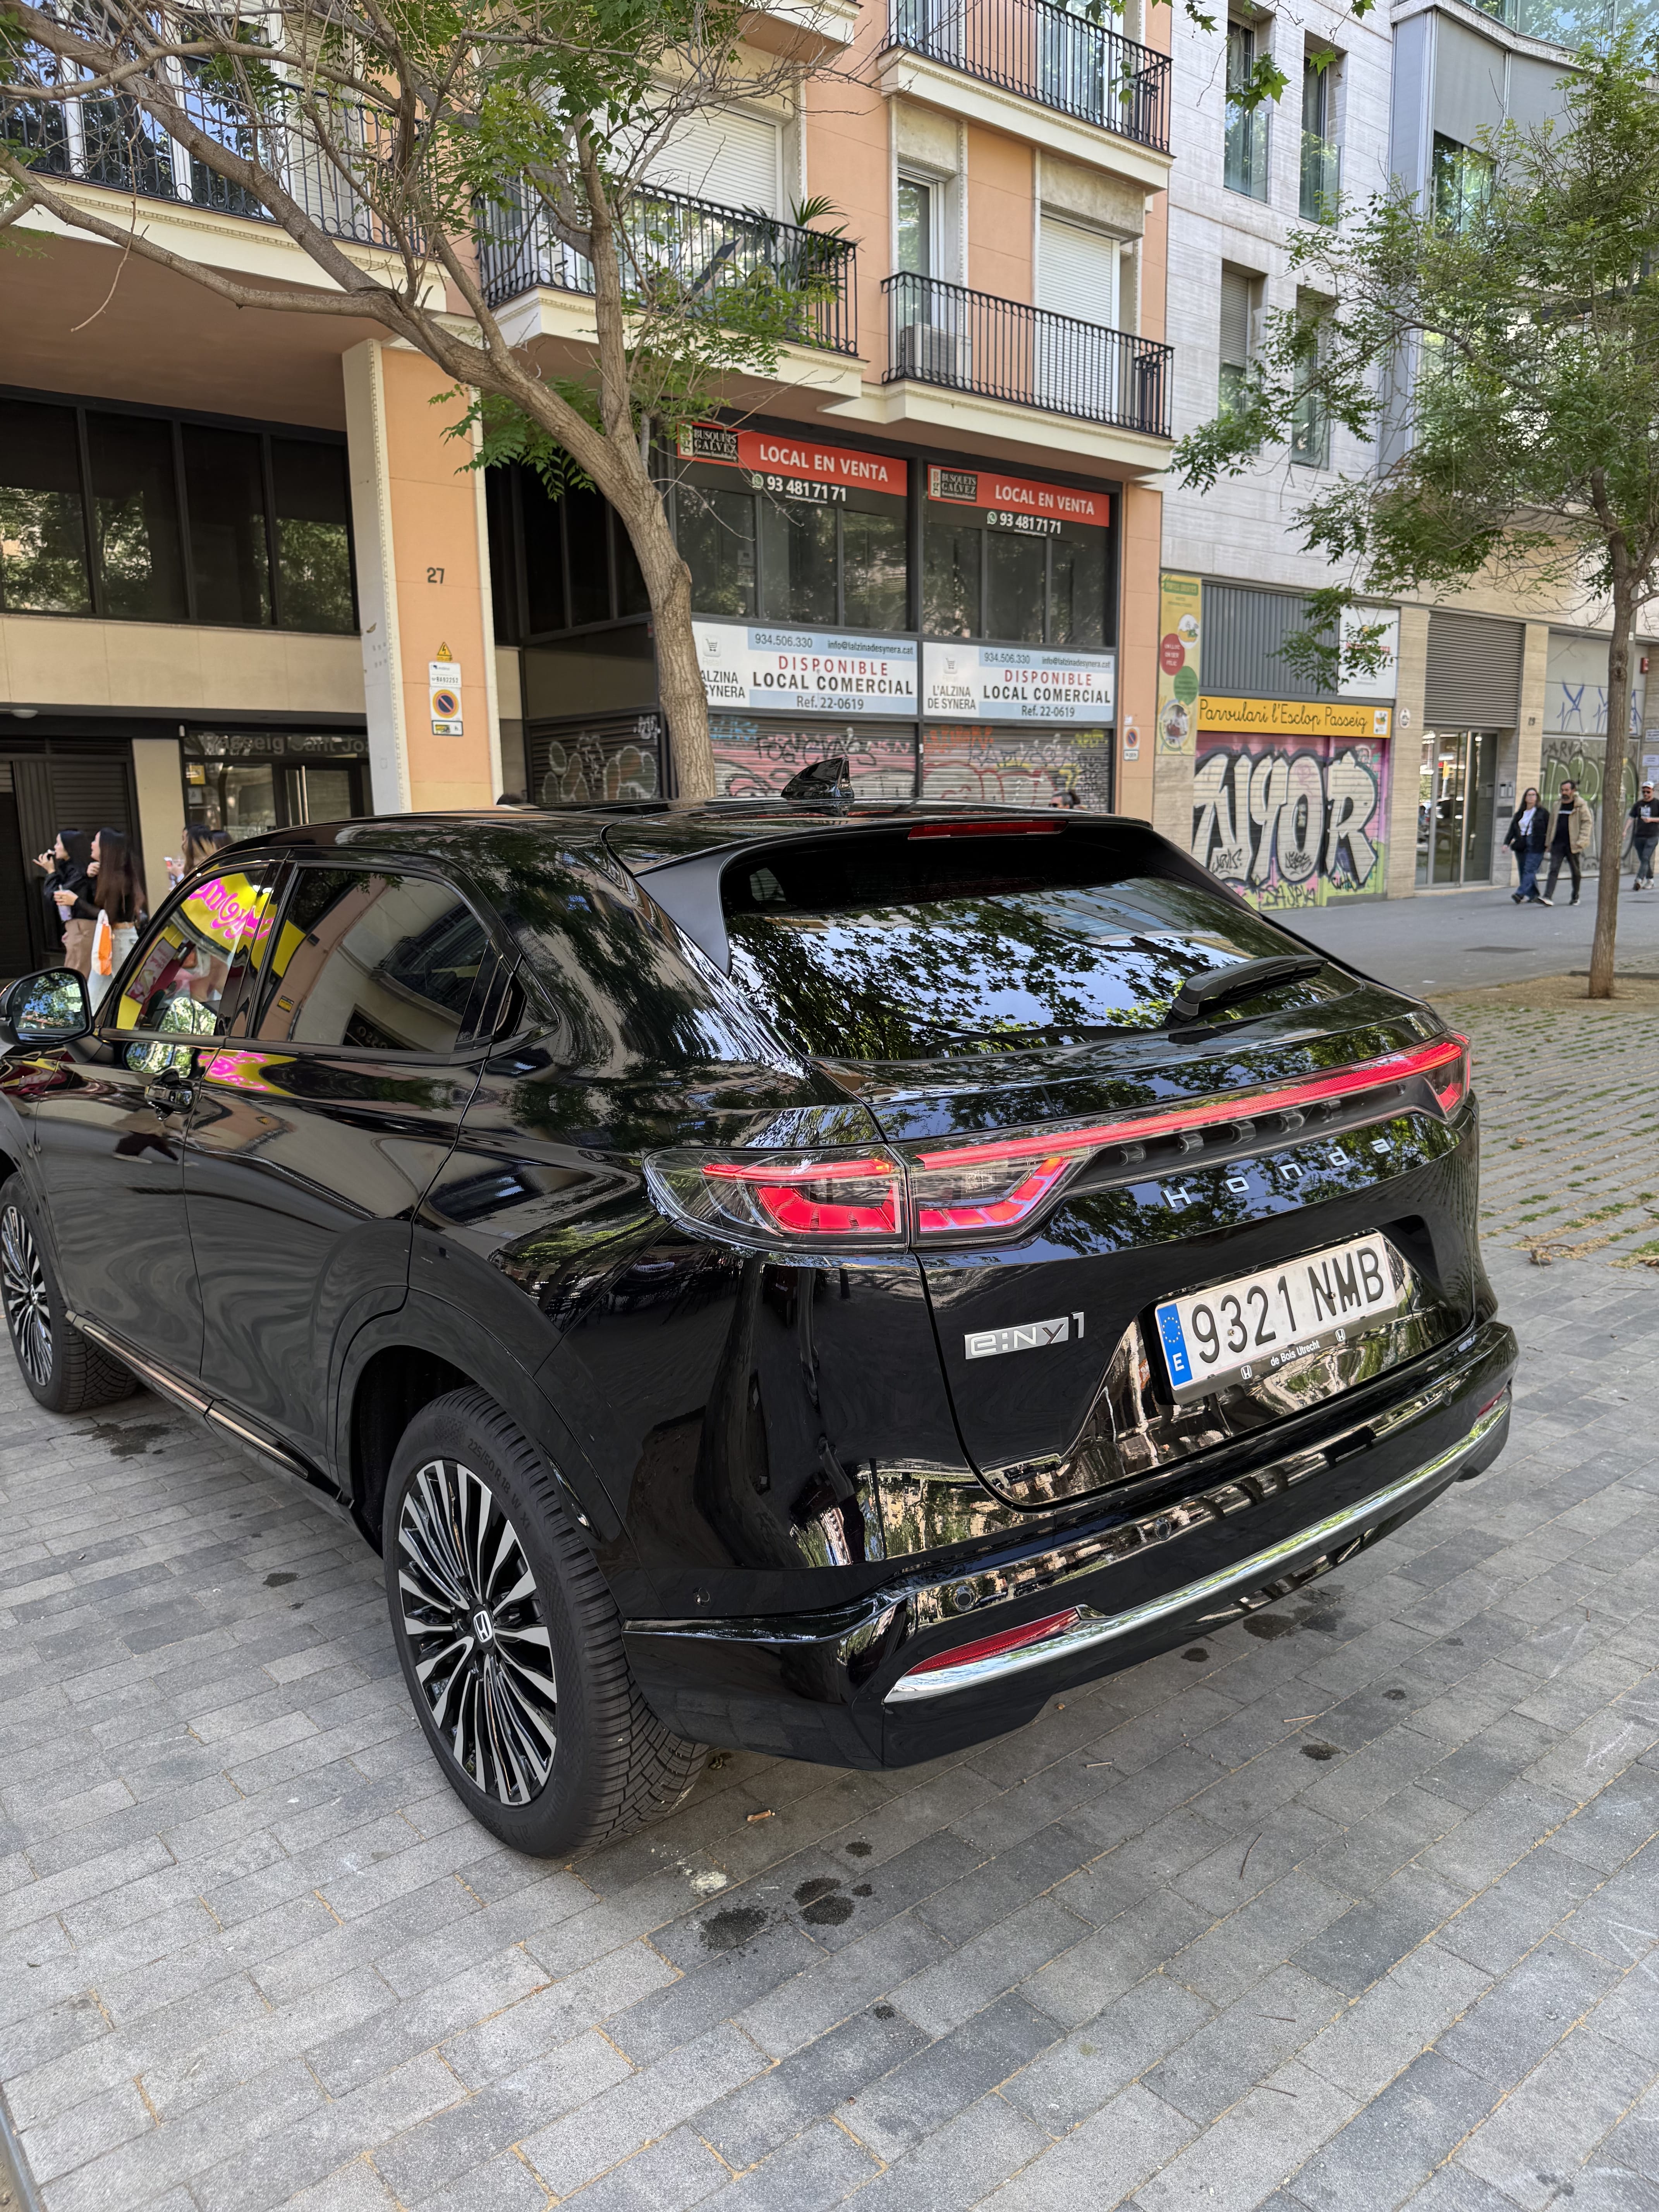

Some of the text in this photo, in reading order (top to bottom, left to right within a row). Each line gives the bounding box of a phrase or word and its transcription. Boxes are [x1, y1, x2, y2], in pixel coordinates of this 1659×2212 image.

[760, 444, 888, 483] LOCAL EN VENTA
[767, 476, 783, 492] 93
[786, 479, 809, 496] 481
[812, 483, 828, 499] 71
[831, 486, 846, 502] 71
[942, 473, 976, 485] BUSQUETS
[995, 484, 1034, 505] LOCAL
[1039, 494, 1053, 508] EN
[1057, 496, 1094, 516] VENTA
[1000, 513, 1013, 527] 93
[1015, 515, 1034, 530] 481
[1036, 518, 1048, 532] 71
[1049, 520, 1061, 534] 71
[426, 567, 445, 584] 27
[755, 634, 813, 649] 934.506.330
[779, 655, 889, 677] DISPONIBLE
[984, 652, 1030, 665] 934.506.330
[701, 670, 738, 684] ALZINA
[753, 672, 913, 695] LOCAL COMERCIAL
[1005, 670, 1092, 687] DISPONIBLE
[933, 685, 970, 697] L'ALZINA
[983, 685, 1111, 704] LOCAL COMERCIAL
[797, 696, 864, 710] Ref. 22-0619
[927, 698, 977, 710] DE SYNERA
[1021, 705, 1075, 717] Ref. 22-0619
[1200, 699, 1267, 723] Parvulari
[1272, 704, 1321, 732] l'Esclop
[1324, 707, 1368, 733] Passeig
[203, 732, 368, 754] Passeig Sant Jo
[1161, 1137, 1392, 1209] Honda
[1191, 1247, 1384, 1364] 9321 NMB
[1173, 1353, 1185, 1372] E
[1270, 1340, 1321, 1367] de Bois Utrecht
[467, 1437, 495, 1472] 225/50
[494, 1467, 502, 1481] R
[501, 1477, 511, 1494] 18
[511, 1492, 522, 1510] W
